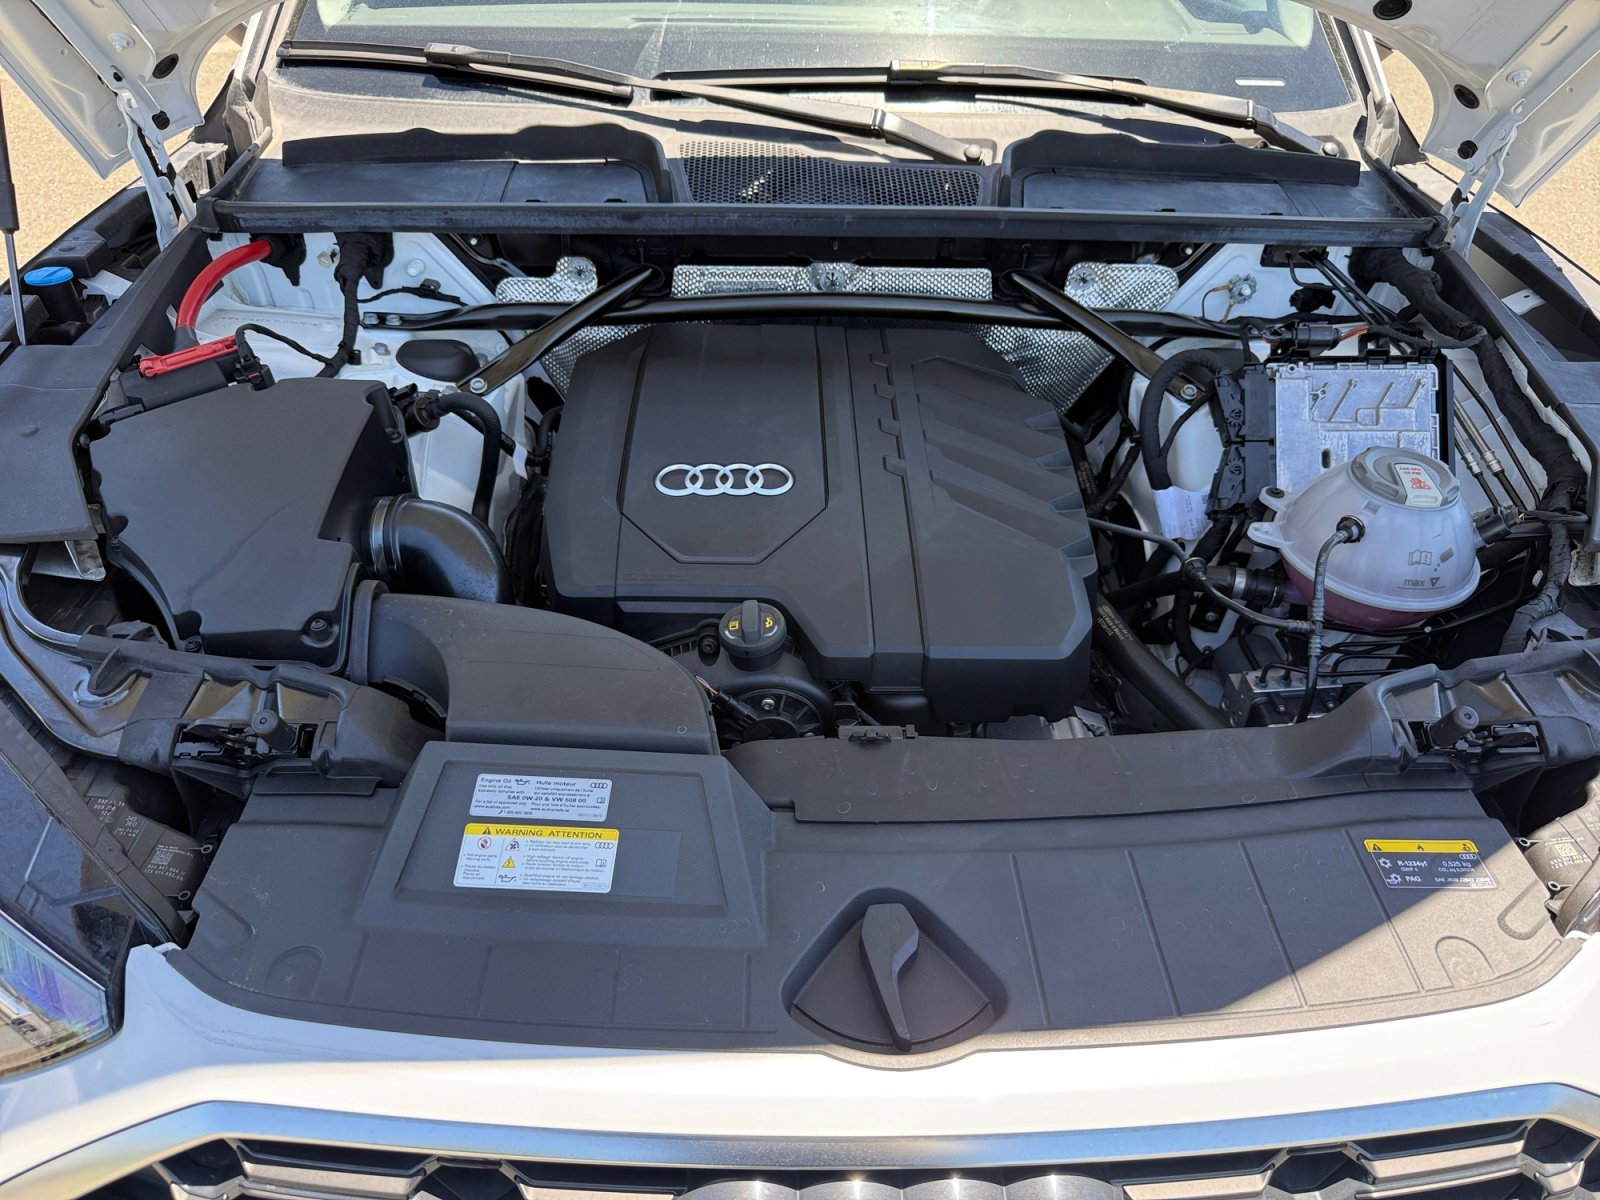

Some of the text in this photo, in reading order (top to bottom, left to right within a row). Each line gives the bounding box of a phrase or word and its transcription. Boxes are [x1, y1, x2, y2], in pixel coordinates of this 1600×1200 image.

[1404, 579, 1424, 587] max
[496, 828, 602, 838] WARNING ATTENTION
